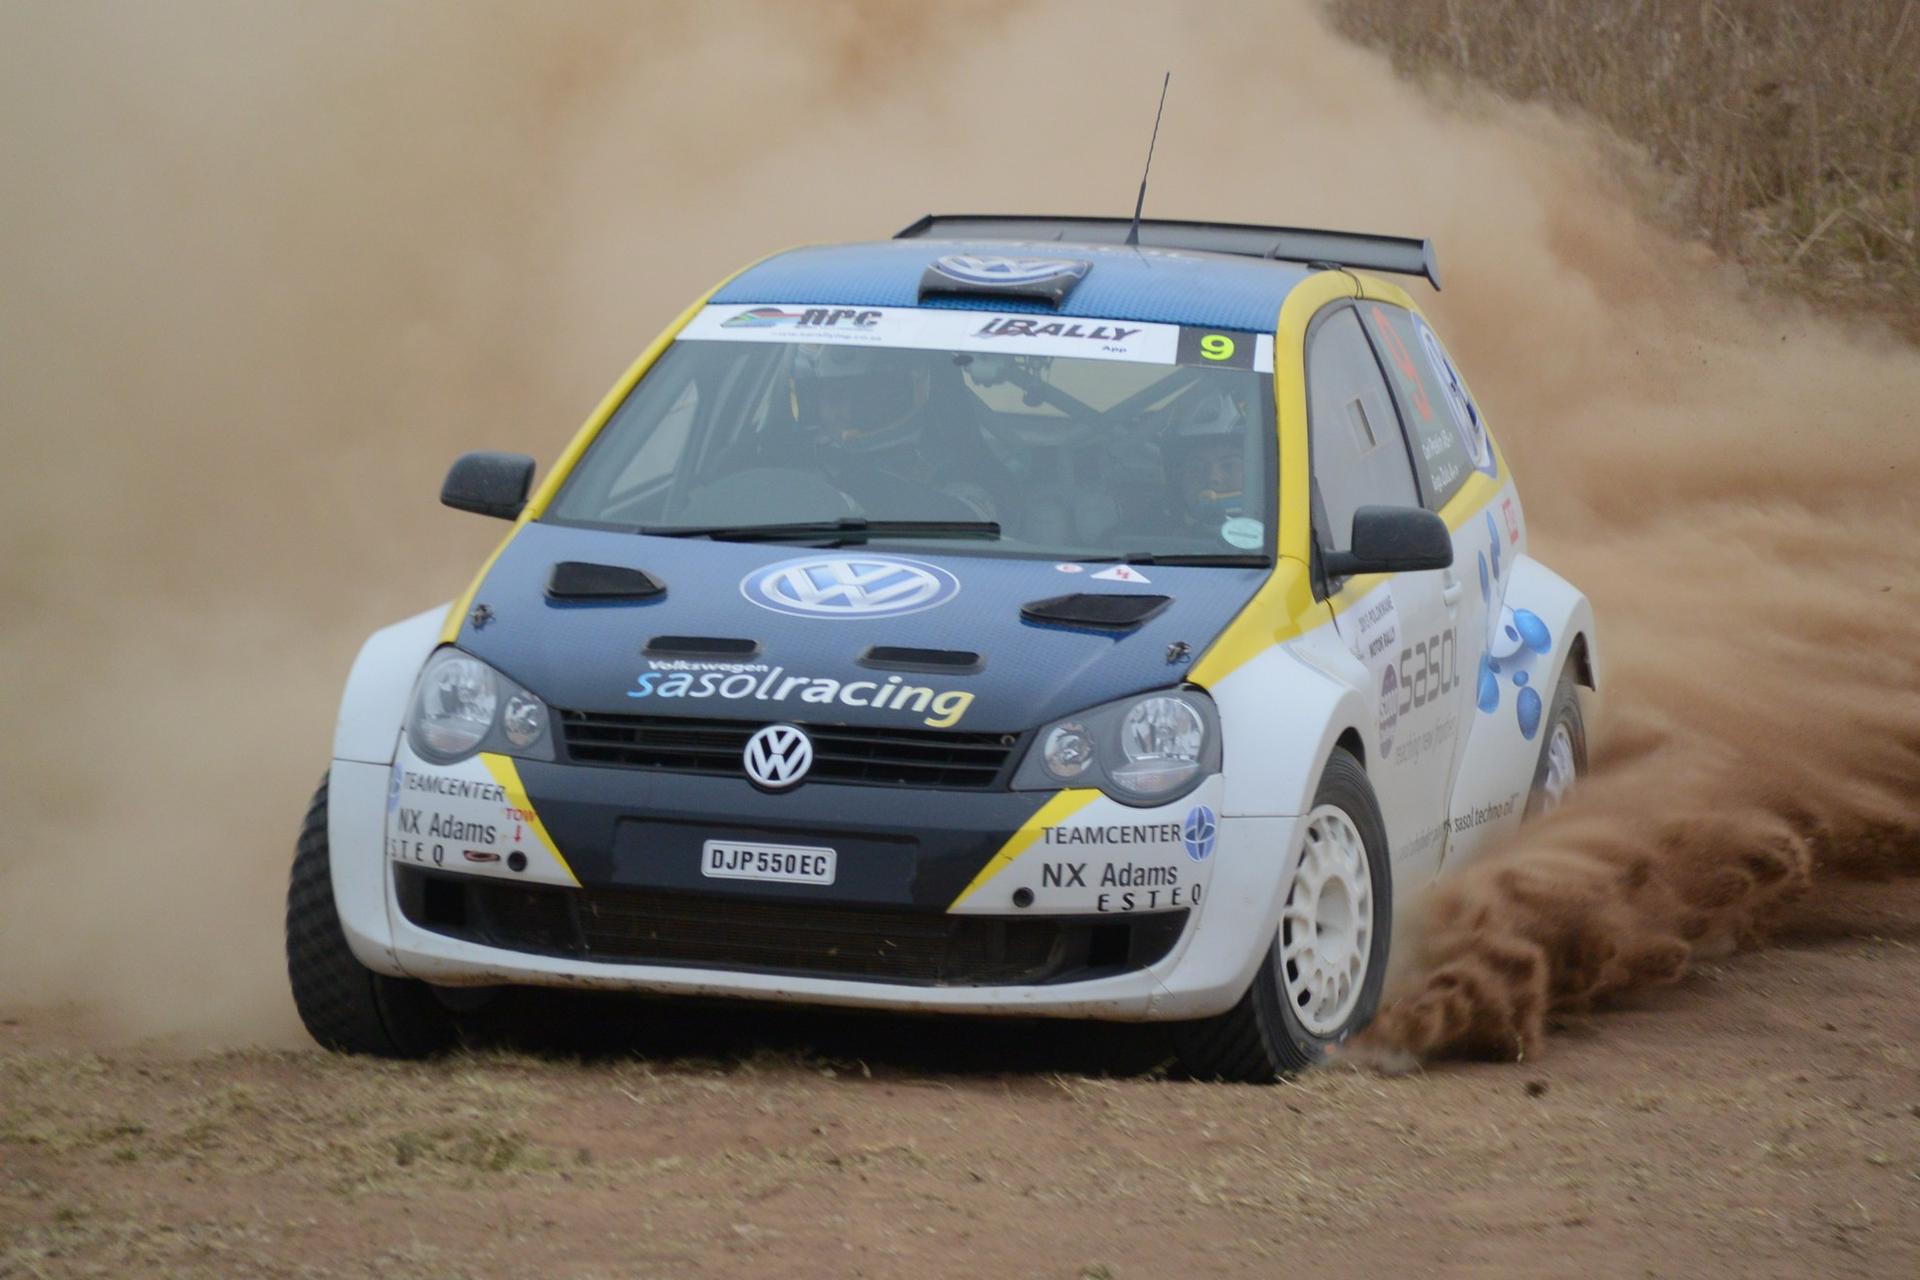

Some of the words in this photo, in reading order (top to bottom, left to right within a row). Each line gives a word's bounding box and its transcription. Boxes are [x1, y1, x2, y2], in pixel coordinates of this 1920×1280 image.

[1201, 335, 1235, 361] 9
[648, 660, 769, 673] Volkswagen
[1399, 626, 1460, 717] sasol
[745, 724, 813, 787] VW
[405, 772, 506, 802] TEAMCENTER
[399, 808, 423, 835] NX
[429, 814, 497, 844] Adams
[505, 807, 536, 823] TOW
[1041, 823, 1182, 845] TEAMCENTER
[711, 849, 827, 876] DJP550EC
[1042, 862, 1088, 888] NX
[1100, 862, 1178, 887] Adams
[1098, 883, 1202, 912] ESTEQ
